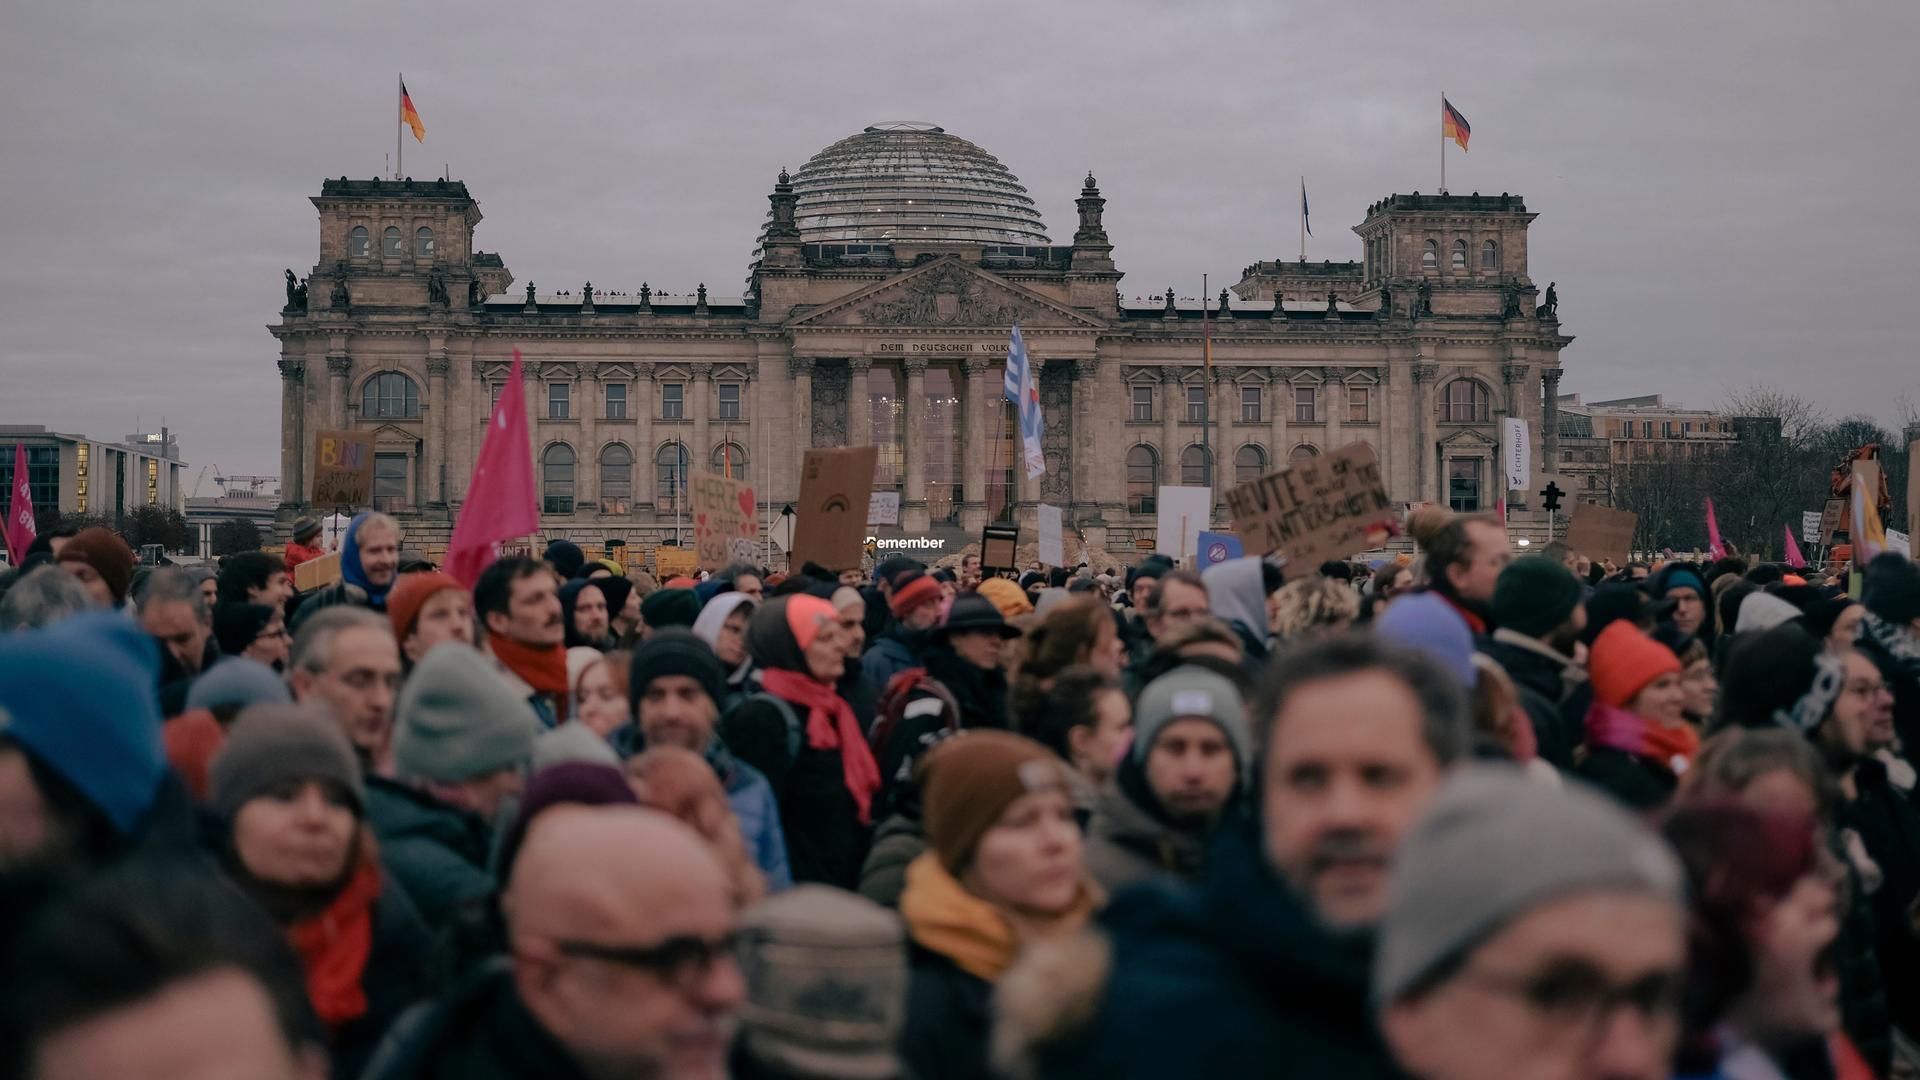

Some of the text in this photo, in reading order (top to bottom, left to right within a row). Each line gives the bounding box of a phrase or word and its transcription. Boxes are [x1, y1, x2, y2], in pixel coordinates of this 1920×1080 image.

[880, 343, 904, 352] DEM
[912, 343, 973, 352] DEUTSCHEN
[320, 437, 369, 470] BUNT
[317, 484, 362, 503] BRUN
[695, 476, 741, 515] HERZ
[1225, 470, 1304, 519] HEUTE
